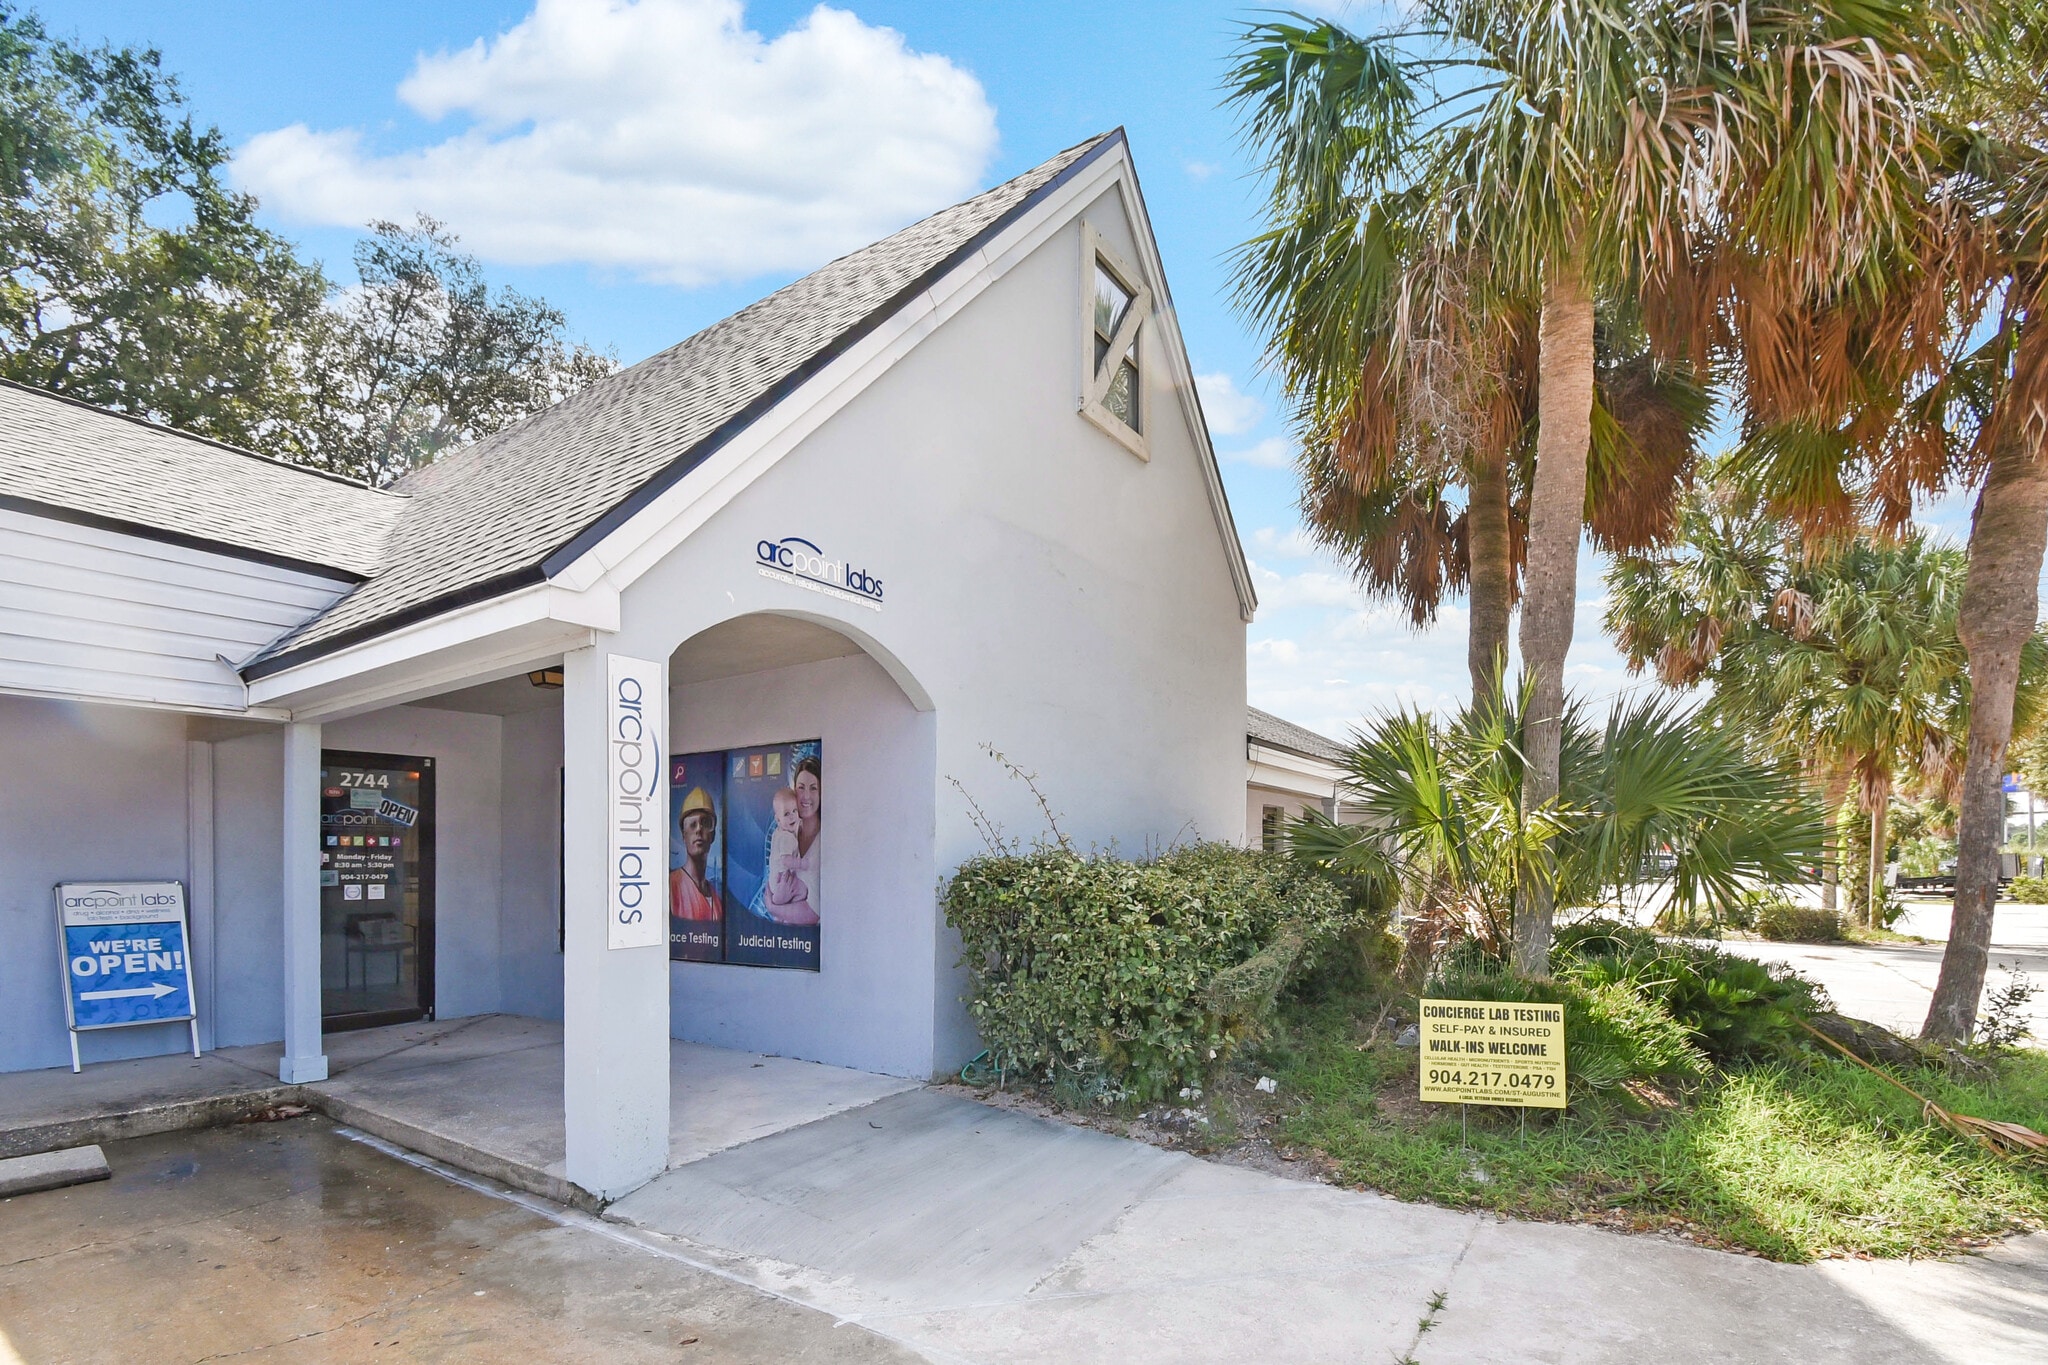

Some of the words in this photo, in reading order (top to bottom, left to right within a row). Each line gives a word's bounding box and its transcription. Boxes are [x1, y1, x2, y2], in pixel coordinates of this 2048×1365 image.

[757, 540, 843, 583] arcpoint
[846, 563, 883, 597] labs
[613, 678, 650, 836] arcpoint
[340, 772, 389, 788] 2744
[321, 812, 378, 826] arcpoint
[379, 800, 416, 824] OPEN
[619, 847, 650, 924] labs
[65, 893, 138, 909] arcpoint
[141, 893, 176, 906] labs
[89, 938, 162, 954] WE'RE
[689, 932, 719, 947] Testing
[738, 934, 775, 949] Judicial
[777, 937, 812, 953] Testing
[71, 951, 183, 977] OPEN!
[1423, 1006, 1485, 1020] CONCIERGE
[1489, 1008, 1510, 1021] LAB
[1514, 1009, 1560, 1023] TESTING
[1432, 1024, 1485, 1035] SELF-PAY
[1488, 1026, 1496, 1035] &
[1500, 1027, 1551, 1038] INSURED
[1429, 1039, 1485, 1054] WALK-INS
[1488, 1042, 1547, 1057] WELCOME
[1429, 1069, 1555, 1089] 904.217.0479
[1424, 1086, 1560, 1098] WWW.ARCPOINTLABS.COM/ST-AUGUSTINE
